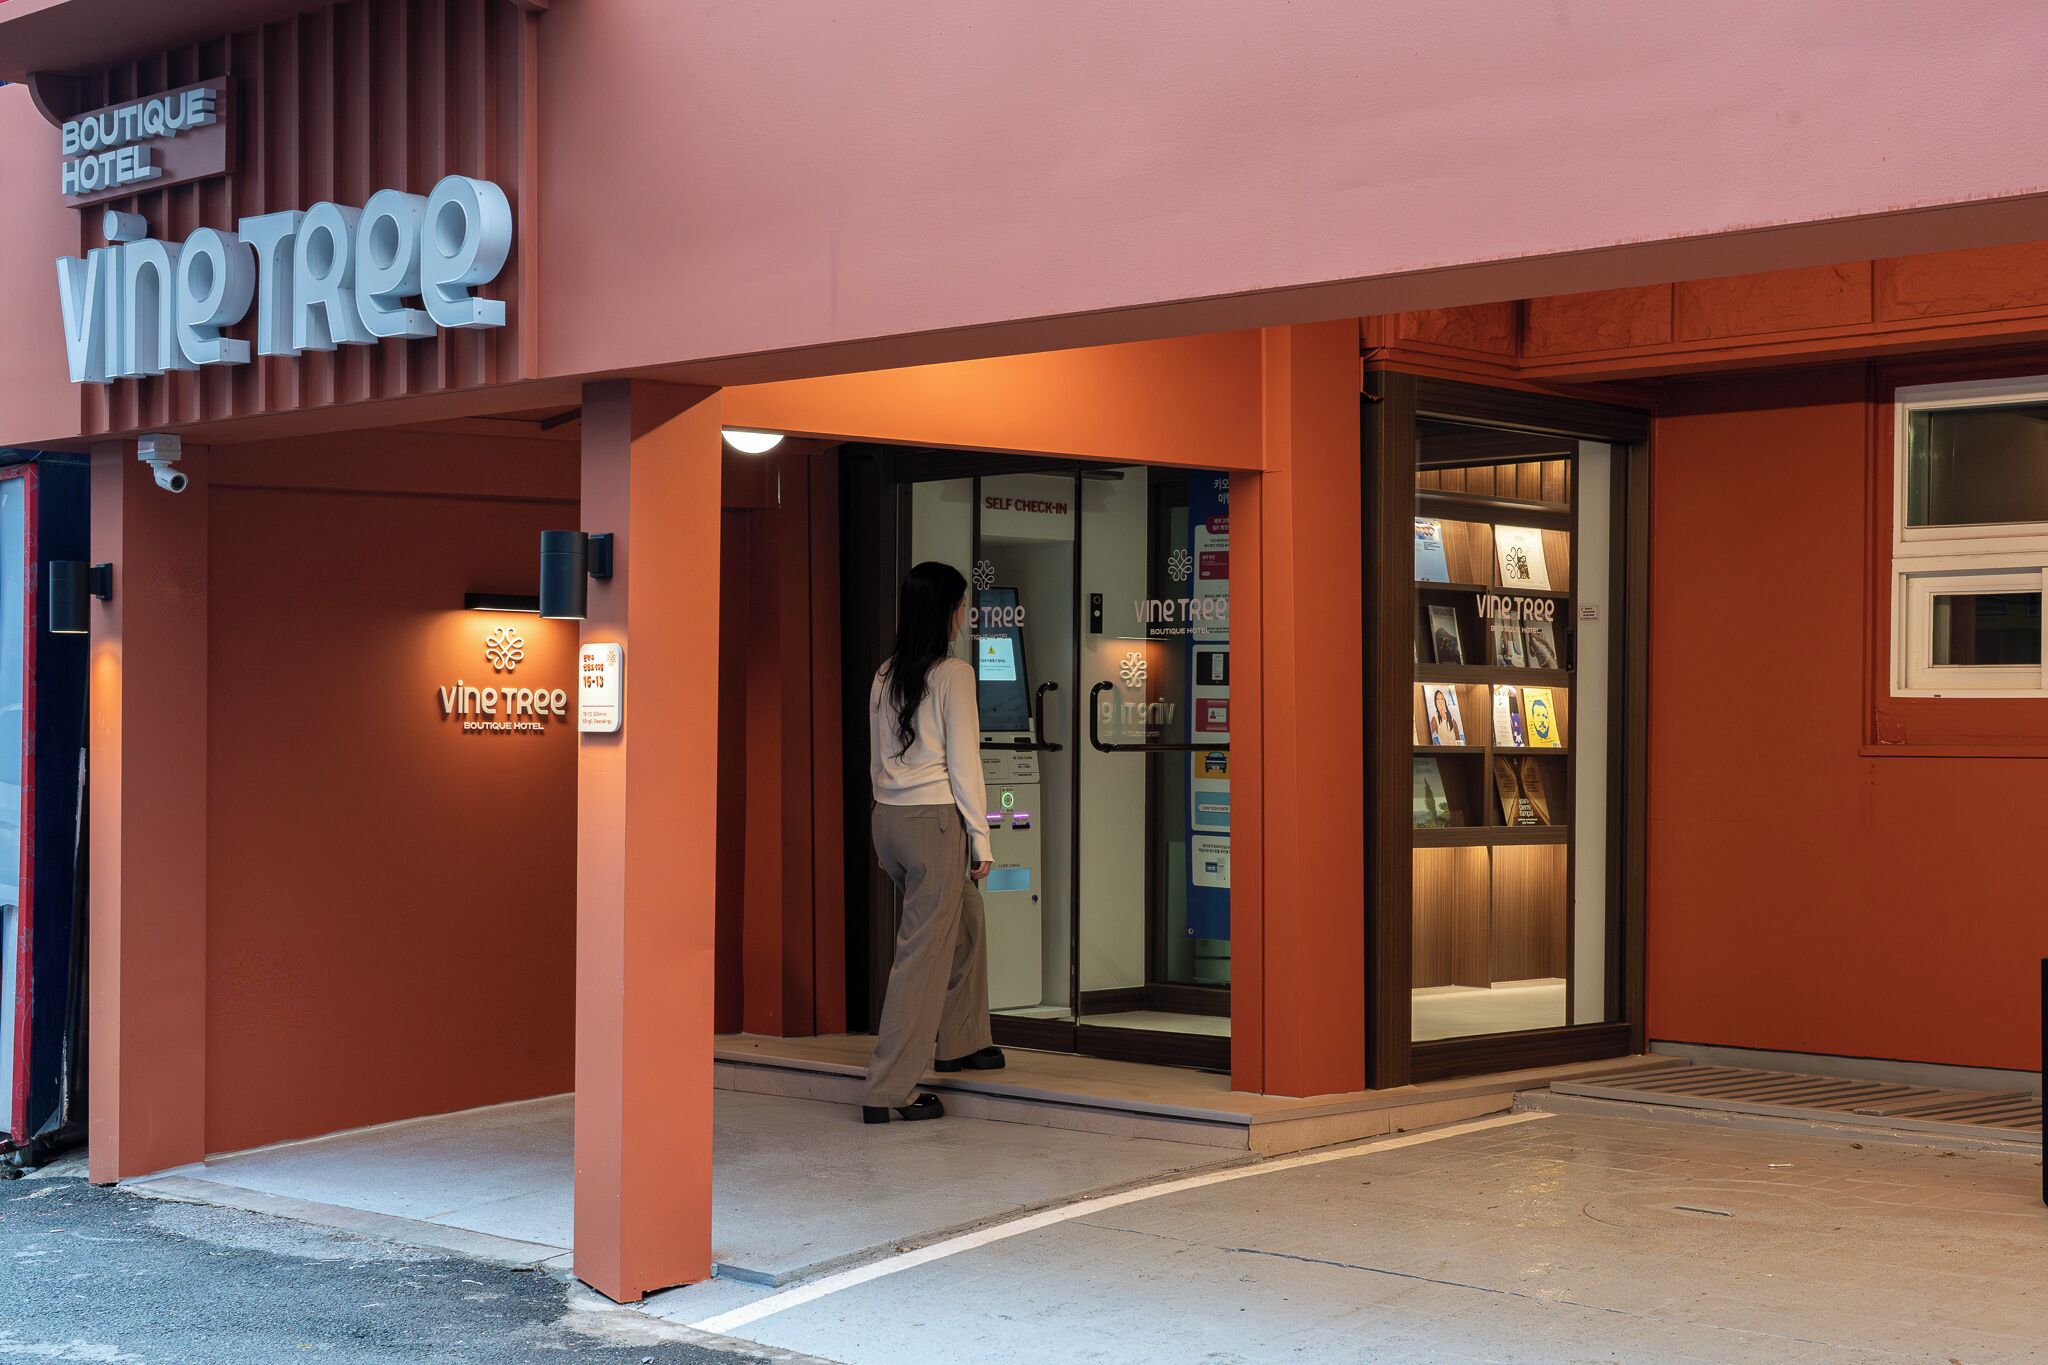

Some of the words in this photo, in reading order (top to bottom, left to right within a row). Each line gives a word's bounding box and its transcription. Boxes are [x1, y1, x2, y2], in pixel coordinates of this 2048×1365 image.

[62, 87, 215, 156] BOUTIQUE
[62, 144, 161, 196] HOTEL
[985, 496, 1013, 510] SELF
[1014, 499, 1068, 515] CHECK-IN
[464, 722, 512, 731] BOUTIQUE
[514, 722, 544, 730] HOTEL
